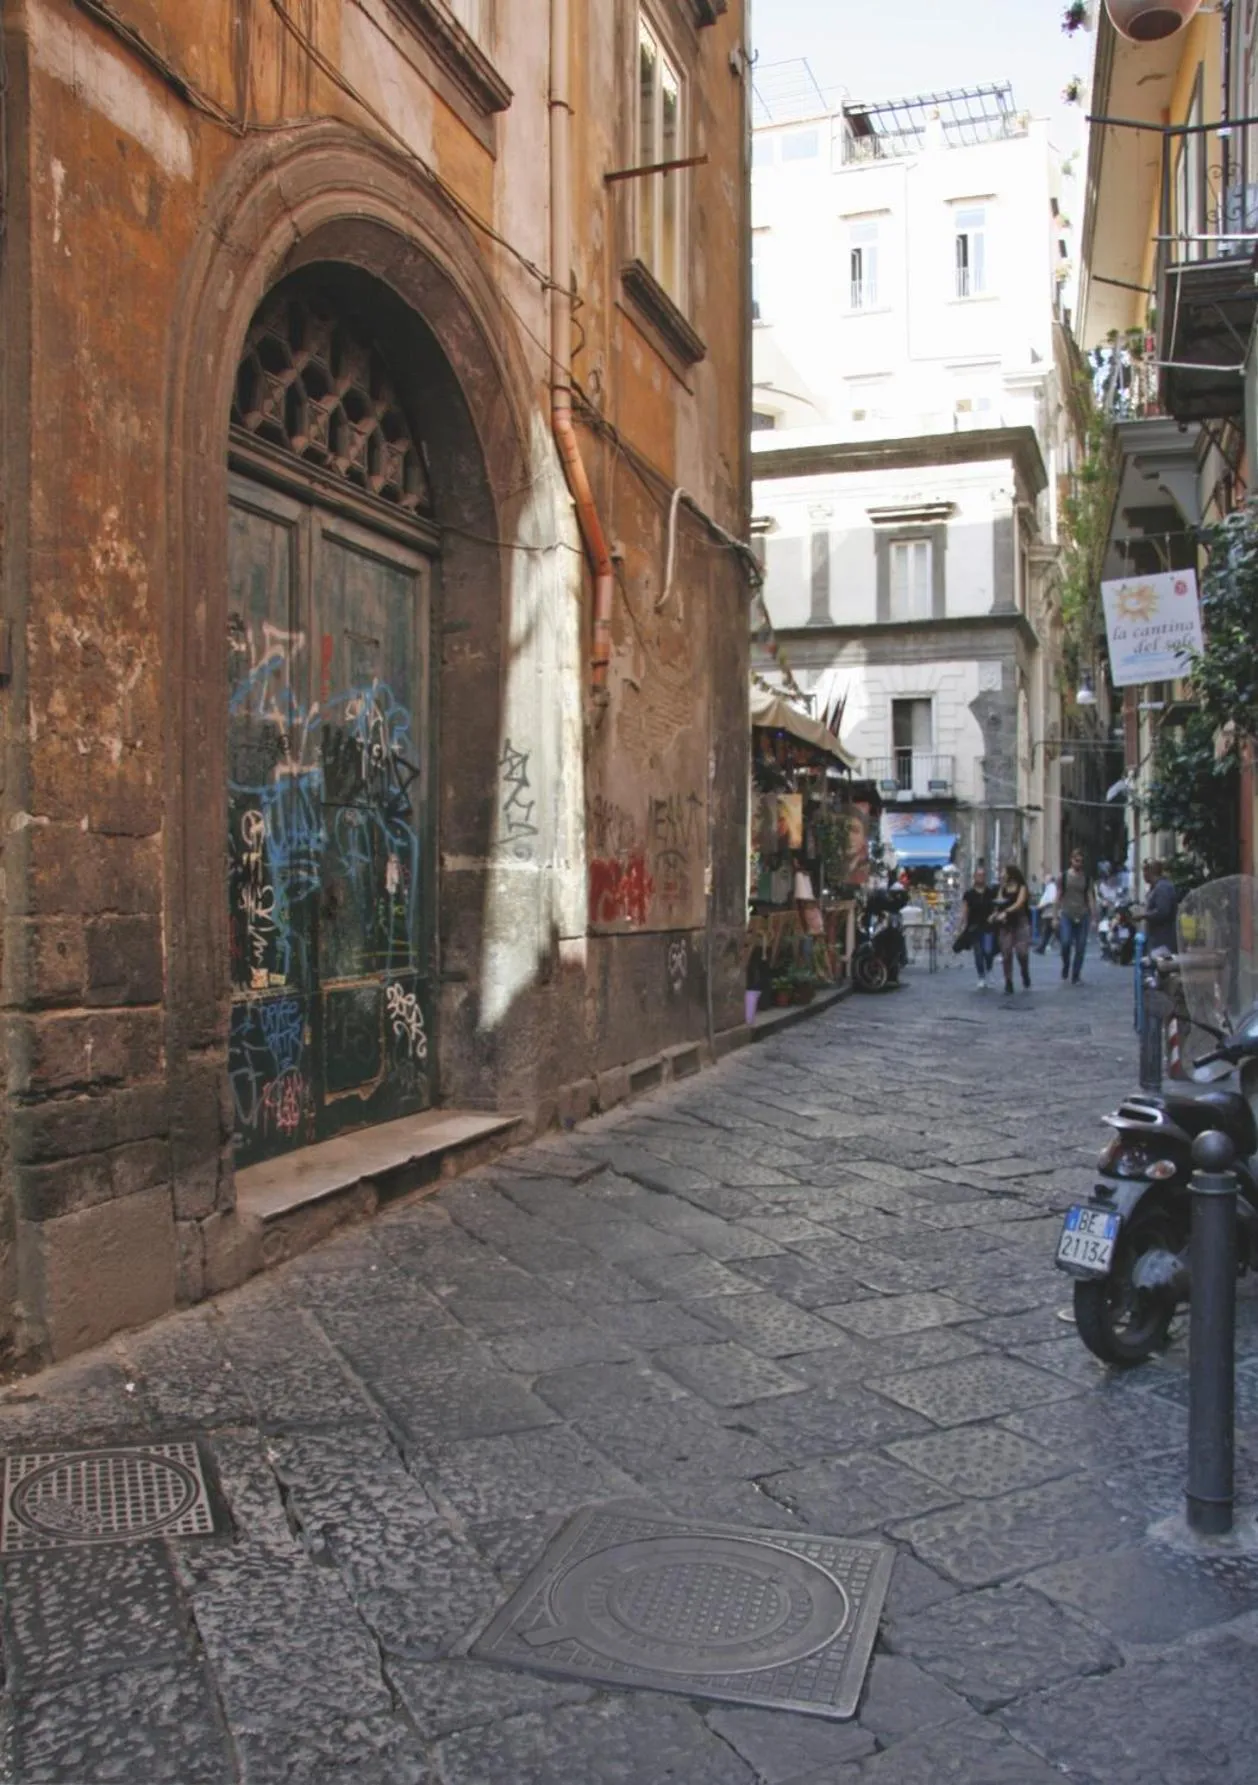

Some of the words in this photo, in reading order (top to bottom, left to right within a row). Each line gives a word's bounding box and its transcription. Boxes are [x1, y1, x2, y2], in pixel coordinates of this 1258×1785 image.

[1112, 626, 1127, 641] la
[1132, 620, 1194, 638] cantina
[1134, 636, 1159, 653] del
[1165, 633, 1196, 651] sole
[1078, 1211, 1099, 1233] BE
